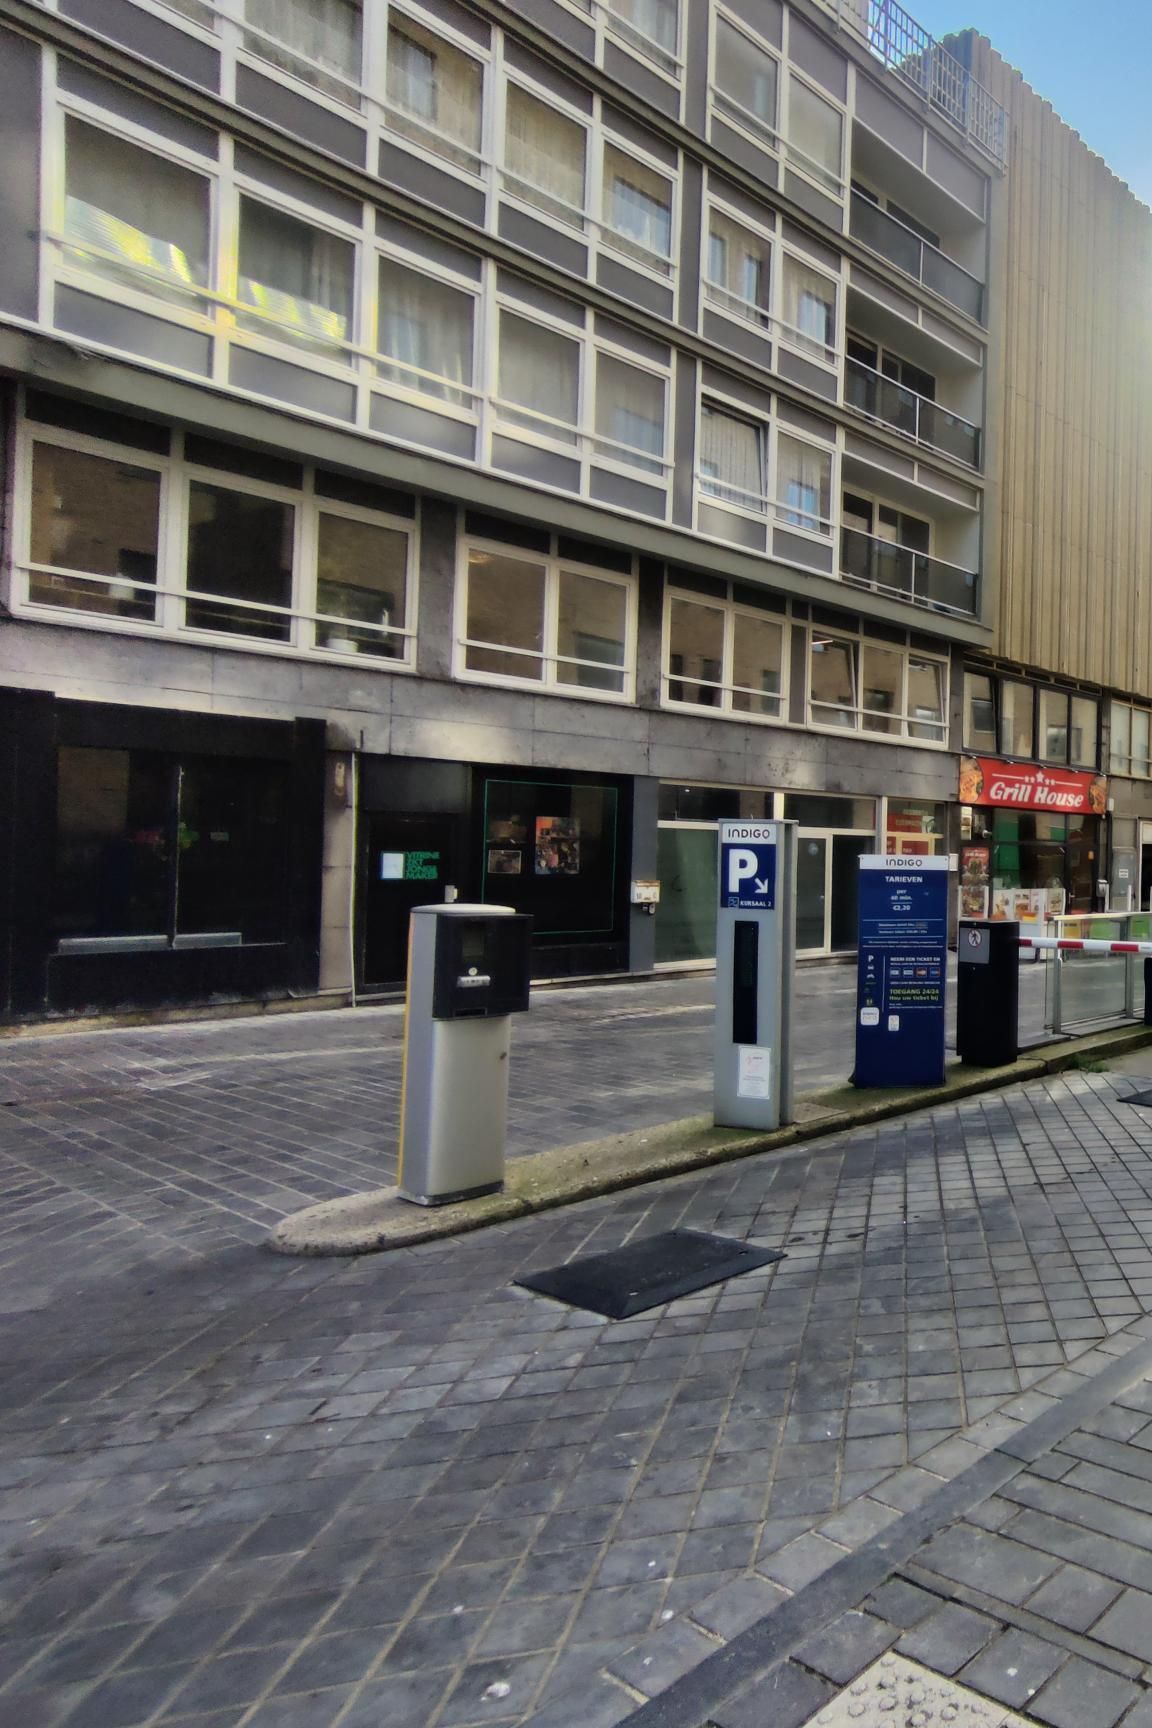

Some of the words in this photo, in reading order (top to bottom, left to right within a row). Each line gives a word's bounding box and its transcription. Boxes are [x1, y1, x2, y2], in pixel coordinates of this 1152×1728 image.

[989, 781, 1032, 803] Grill
[1033, 786, 1084, 808] House
[728, 828, 771, 839] INDIGO
[728, 848, 758, 893] P
[885, 858, 923, 867] INDIGO
